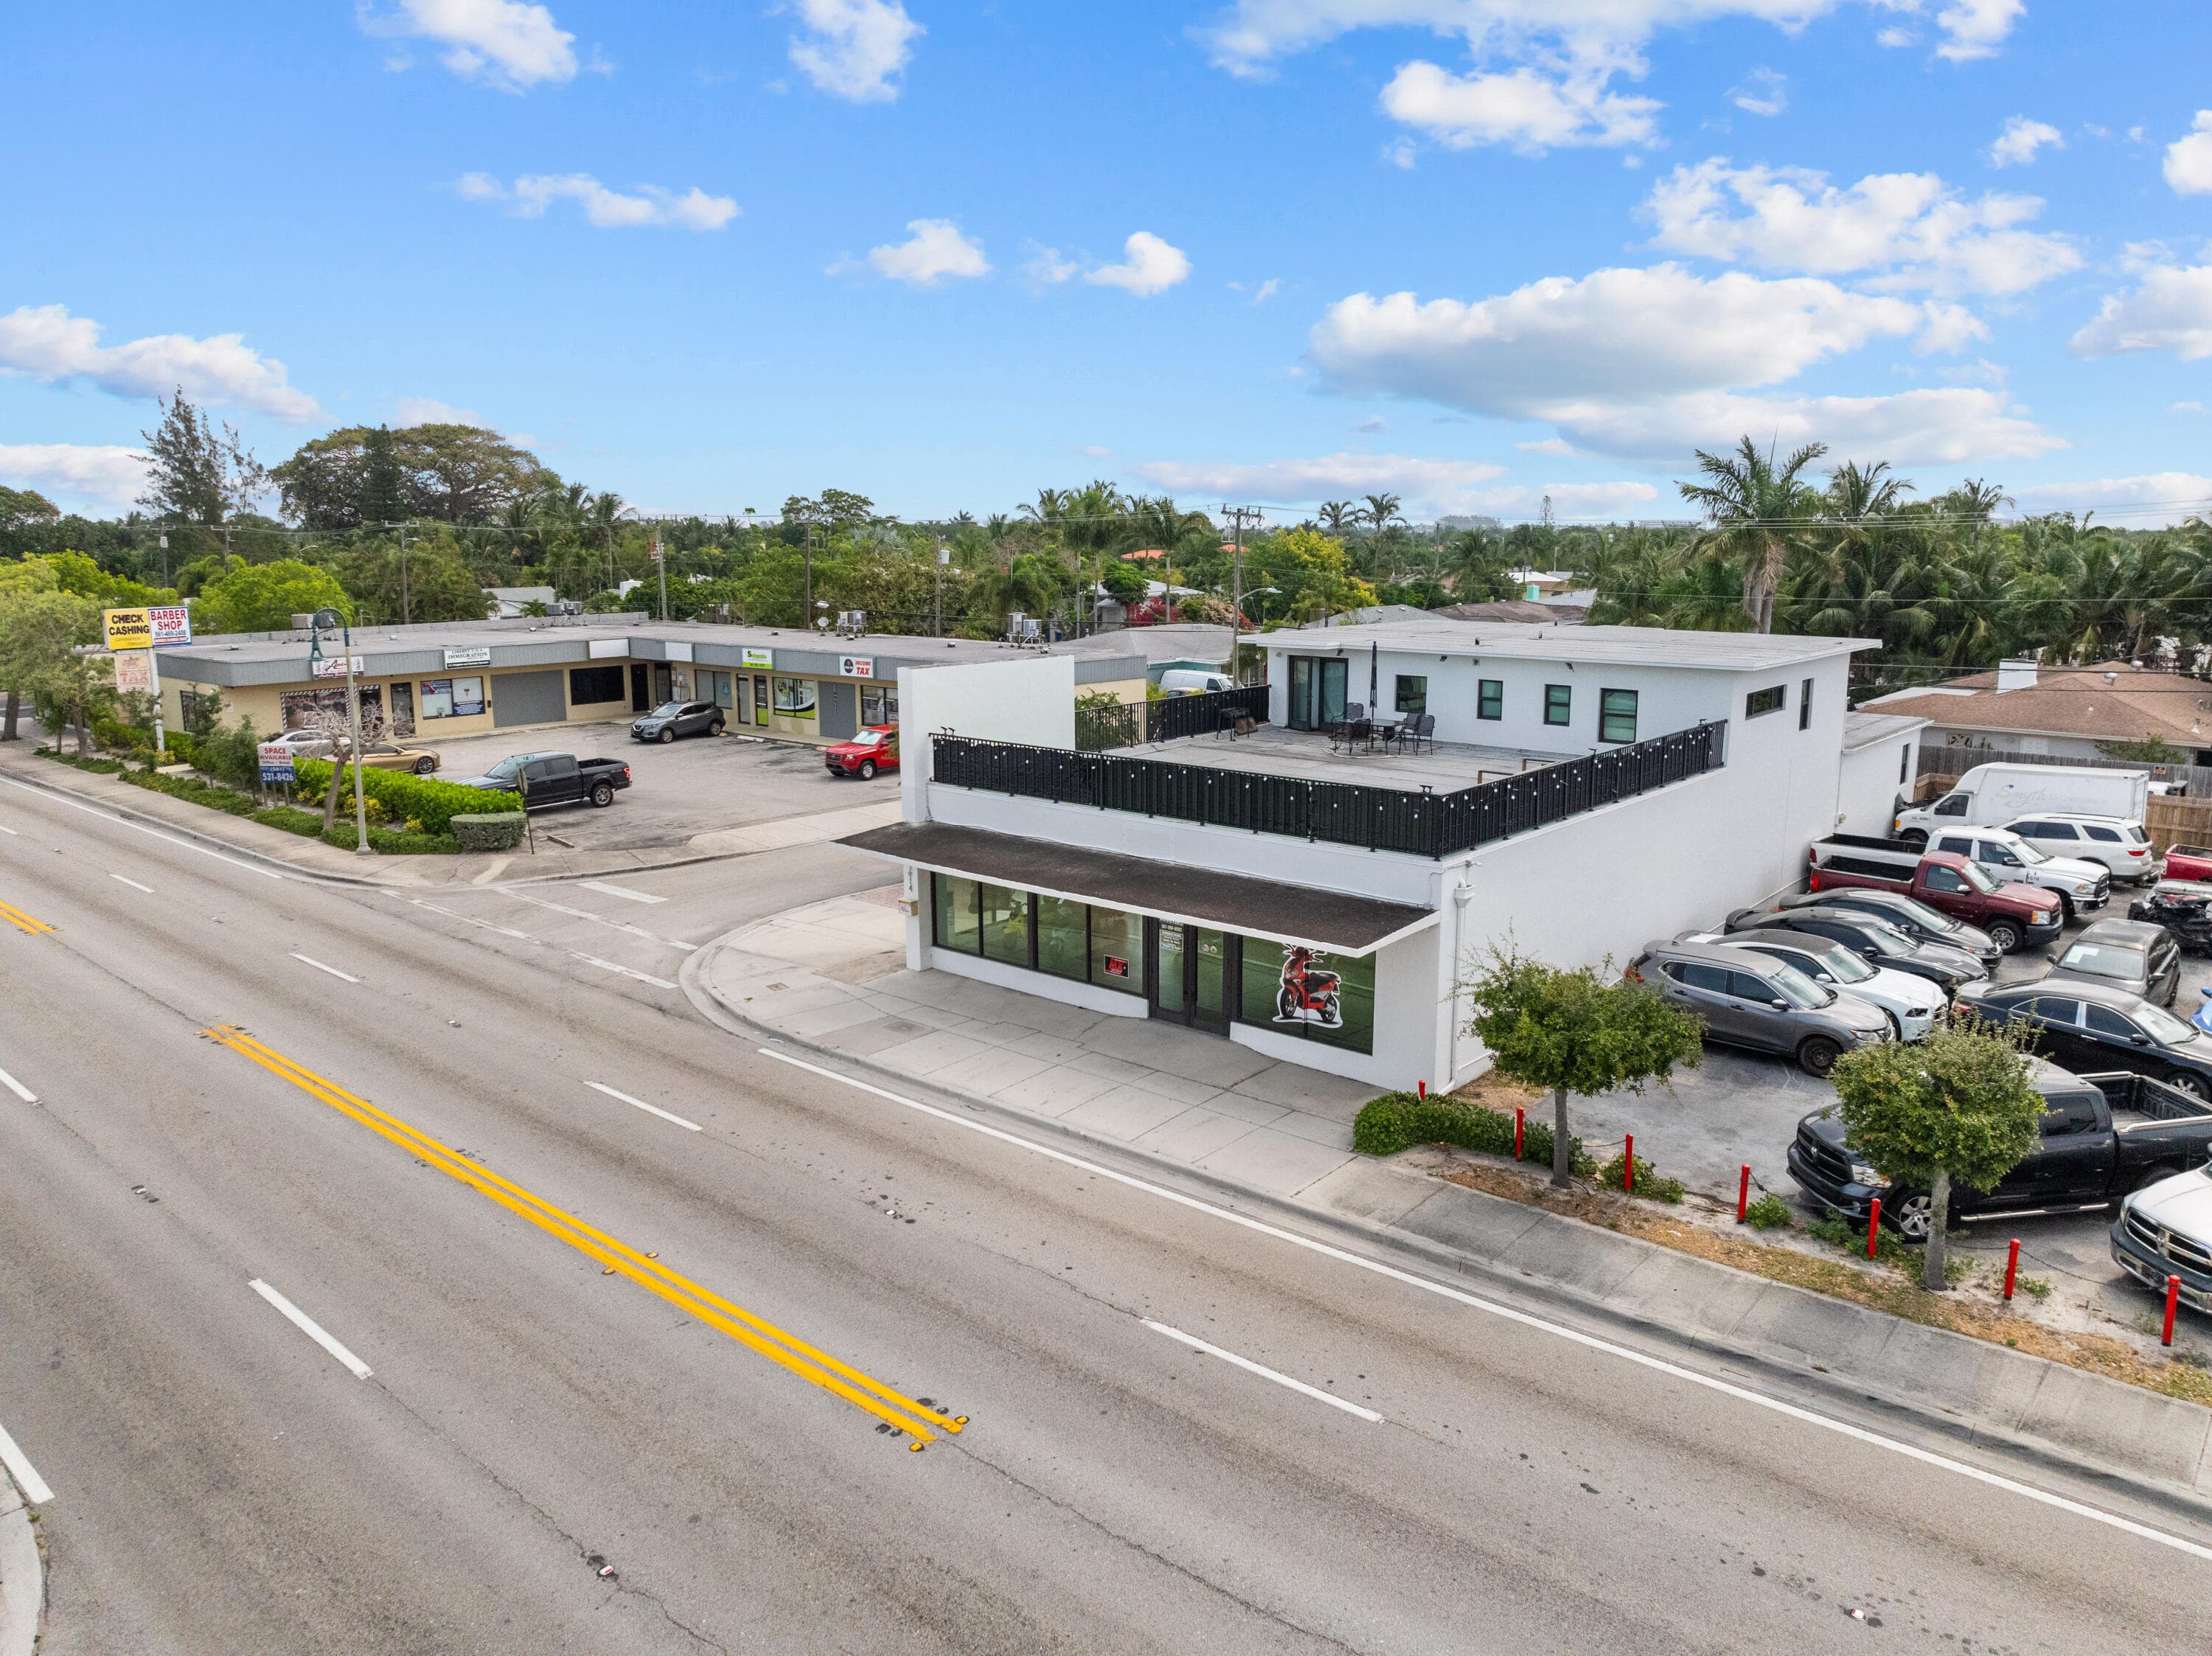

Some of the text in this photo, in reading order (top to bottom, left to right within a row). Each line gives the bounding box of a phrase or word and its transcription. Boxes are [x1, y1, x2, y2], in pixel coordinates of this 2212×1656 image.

[111, 614, 145, 625] CHECK
[150, 610, 187, 621] BARBER
[108, 625, 150, 636] CASHING
[158, 621, 182, 630] SHOP
[856, 667, 870, 675] TAX
[262, 773, 294, 782] 531-8426
